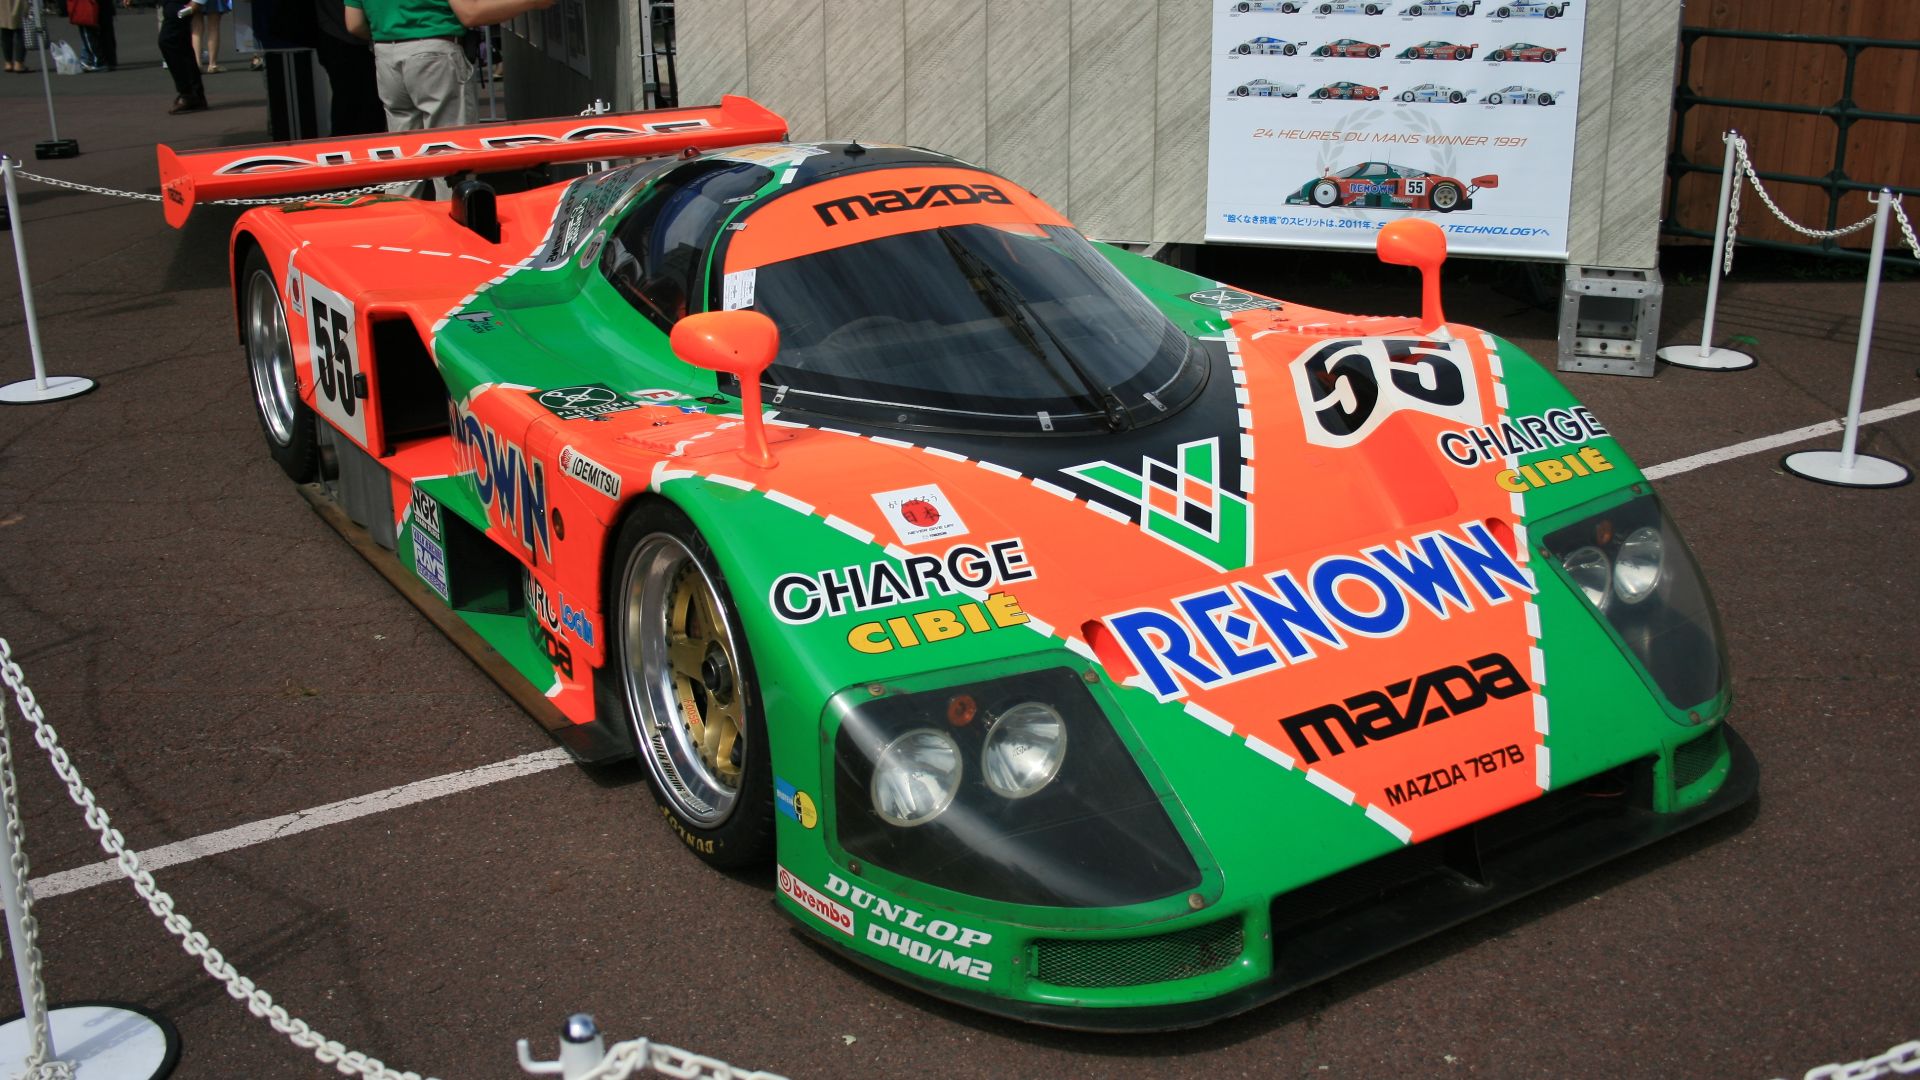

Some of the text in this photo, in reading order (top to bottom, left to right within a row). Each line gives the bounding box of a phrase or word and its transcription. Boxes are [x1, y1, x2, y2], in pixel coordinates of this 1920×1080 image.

[1253, 128, 1528, 148] 24 HEURES DU MANS WINNER 1991
[1350, 183, 1395, 194] RENOWN
[1408, 181, 1423, 194] 55
[311, 296, 356, 417] 55
[1304, 339, 1465, 437] 55
[1438, 406, 1609, 468] CHARGE
[571, 456, 620, 498] IDEMITSU
[1495, 445, 1616, 494] CIBIÉ
[412, 487, 439, 530] NGK
[902, 506, 942, 523] 日本
[771, 538, 1036, 624] CHARGE
[847, 591, 1031, 655] CIBIÉ
[1102, 520, 1538, 704] RENOWN
[1384, 743, 1525, 807] MAZDA 787B
[793, 878, 851, 928] brembo
[824, 872, 993, 949] DUNLOP
[866, 923, 993, 981] D40/M2
